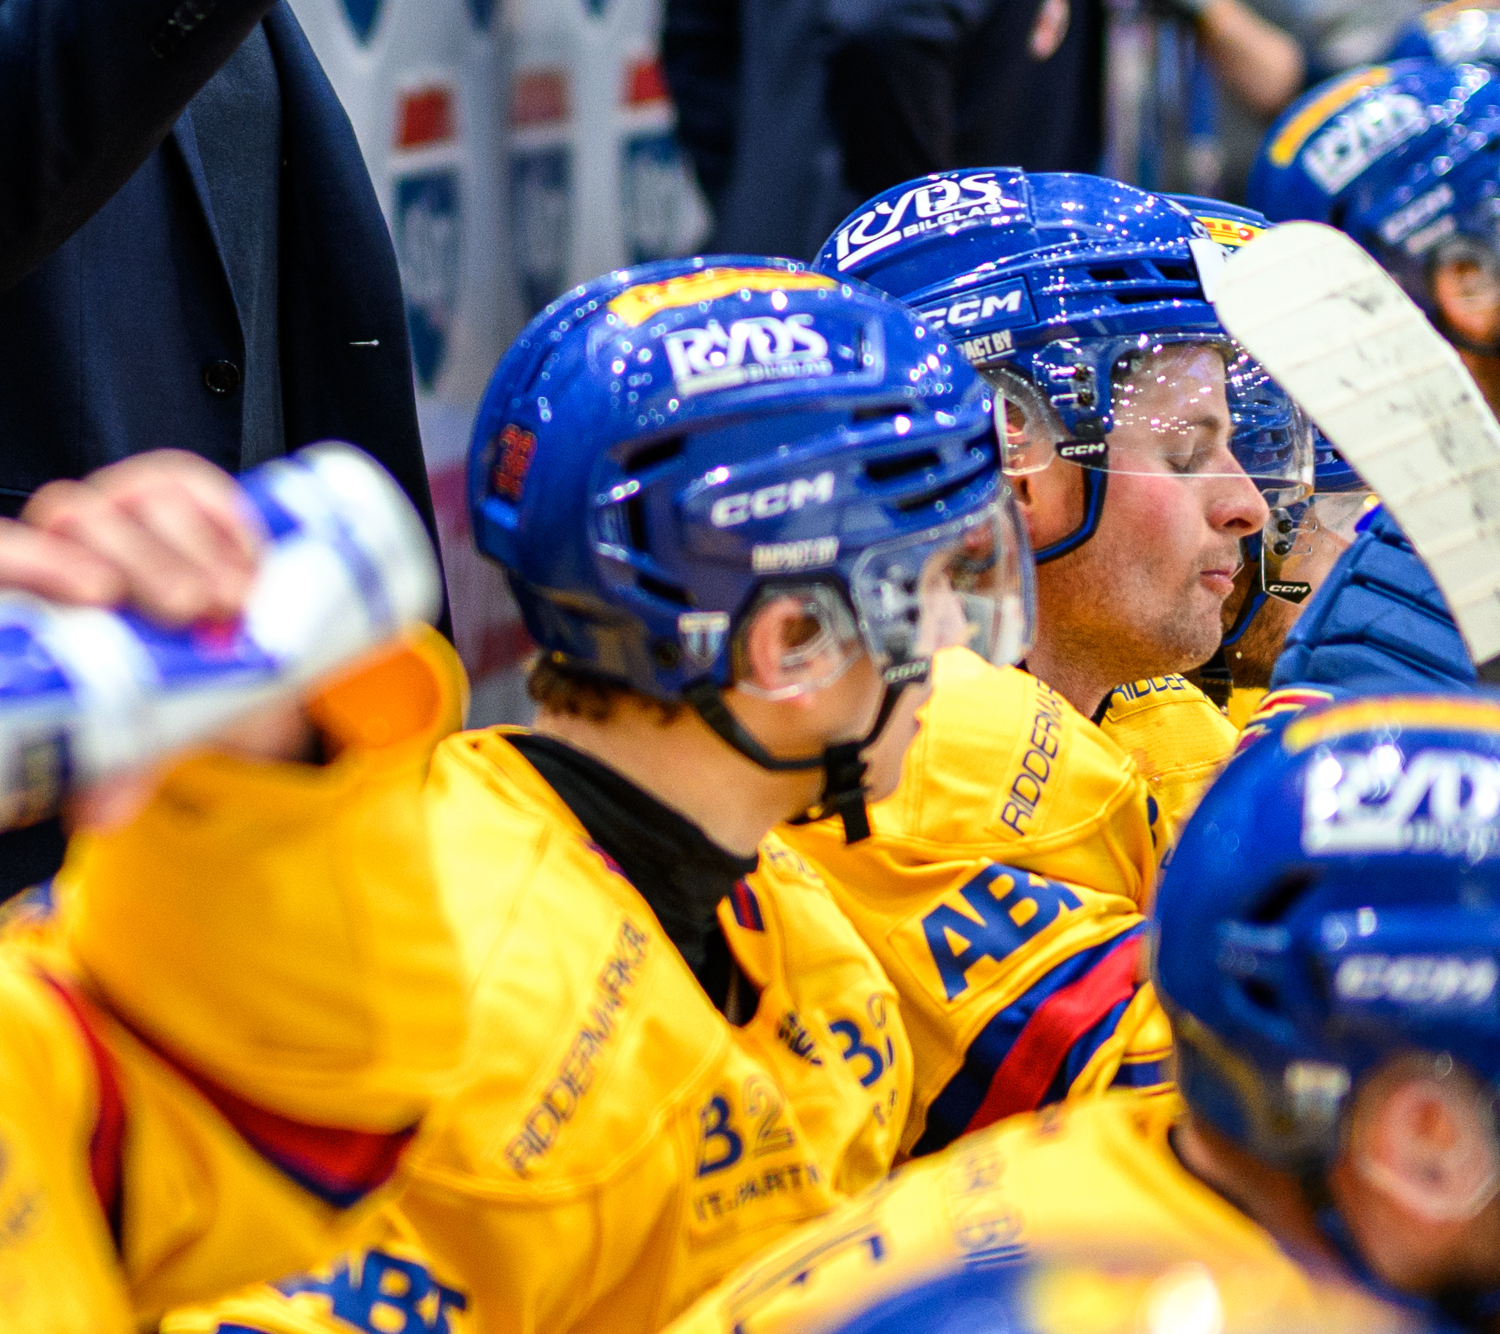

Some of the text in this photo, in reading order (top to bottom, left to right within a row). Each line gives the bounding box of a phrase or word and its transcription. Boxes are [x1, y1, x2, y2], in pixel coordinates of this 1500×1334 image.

[836, 173, 1002, 260] RYDS
[903, 203, 1002, 238] BILGLAS
[918, 289, 1022, 330] CCM
[1060, 441, 1105, 458] CCM
[710, 470, 835, 528] CCM
[1268, 584, 1309, 593] CCM
